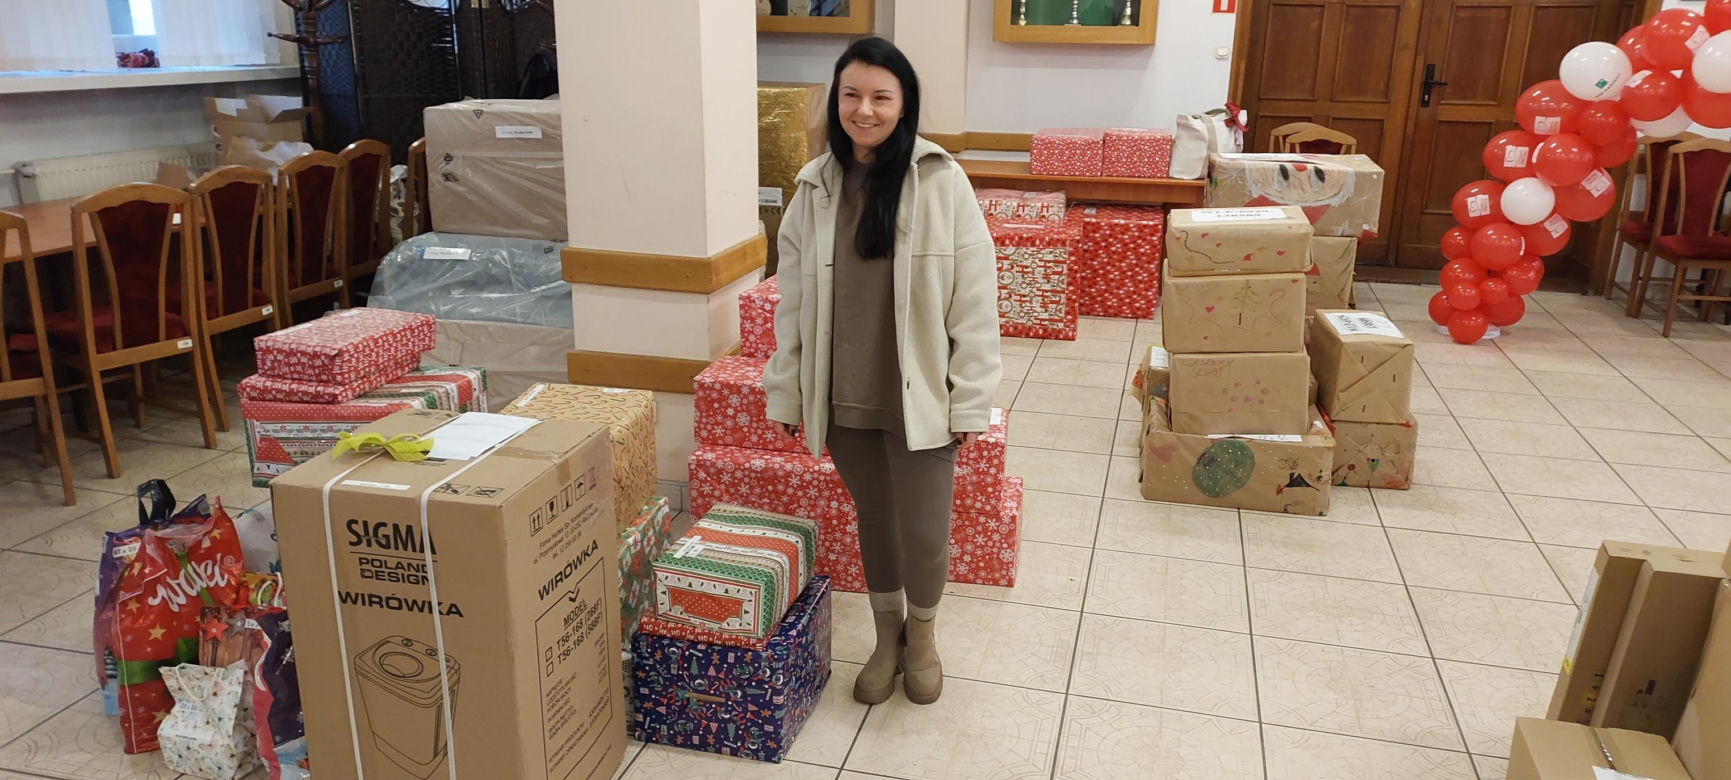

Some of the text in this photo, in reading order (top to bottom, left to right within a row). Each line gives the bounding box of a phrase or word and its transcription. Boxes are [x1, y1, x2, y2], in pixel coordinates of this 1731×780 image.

[346, 518, 437, 555] SIGMA
[360, 568, 430, 586] DESIGN
[538, 539, 598, 601] WIRÓWKA
[338, 590, 464, 618] WIRÓWKA
[563, 599, 588, 627] MODEL
